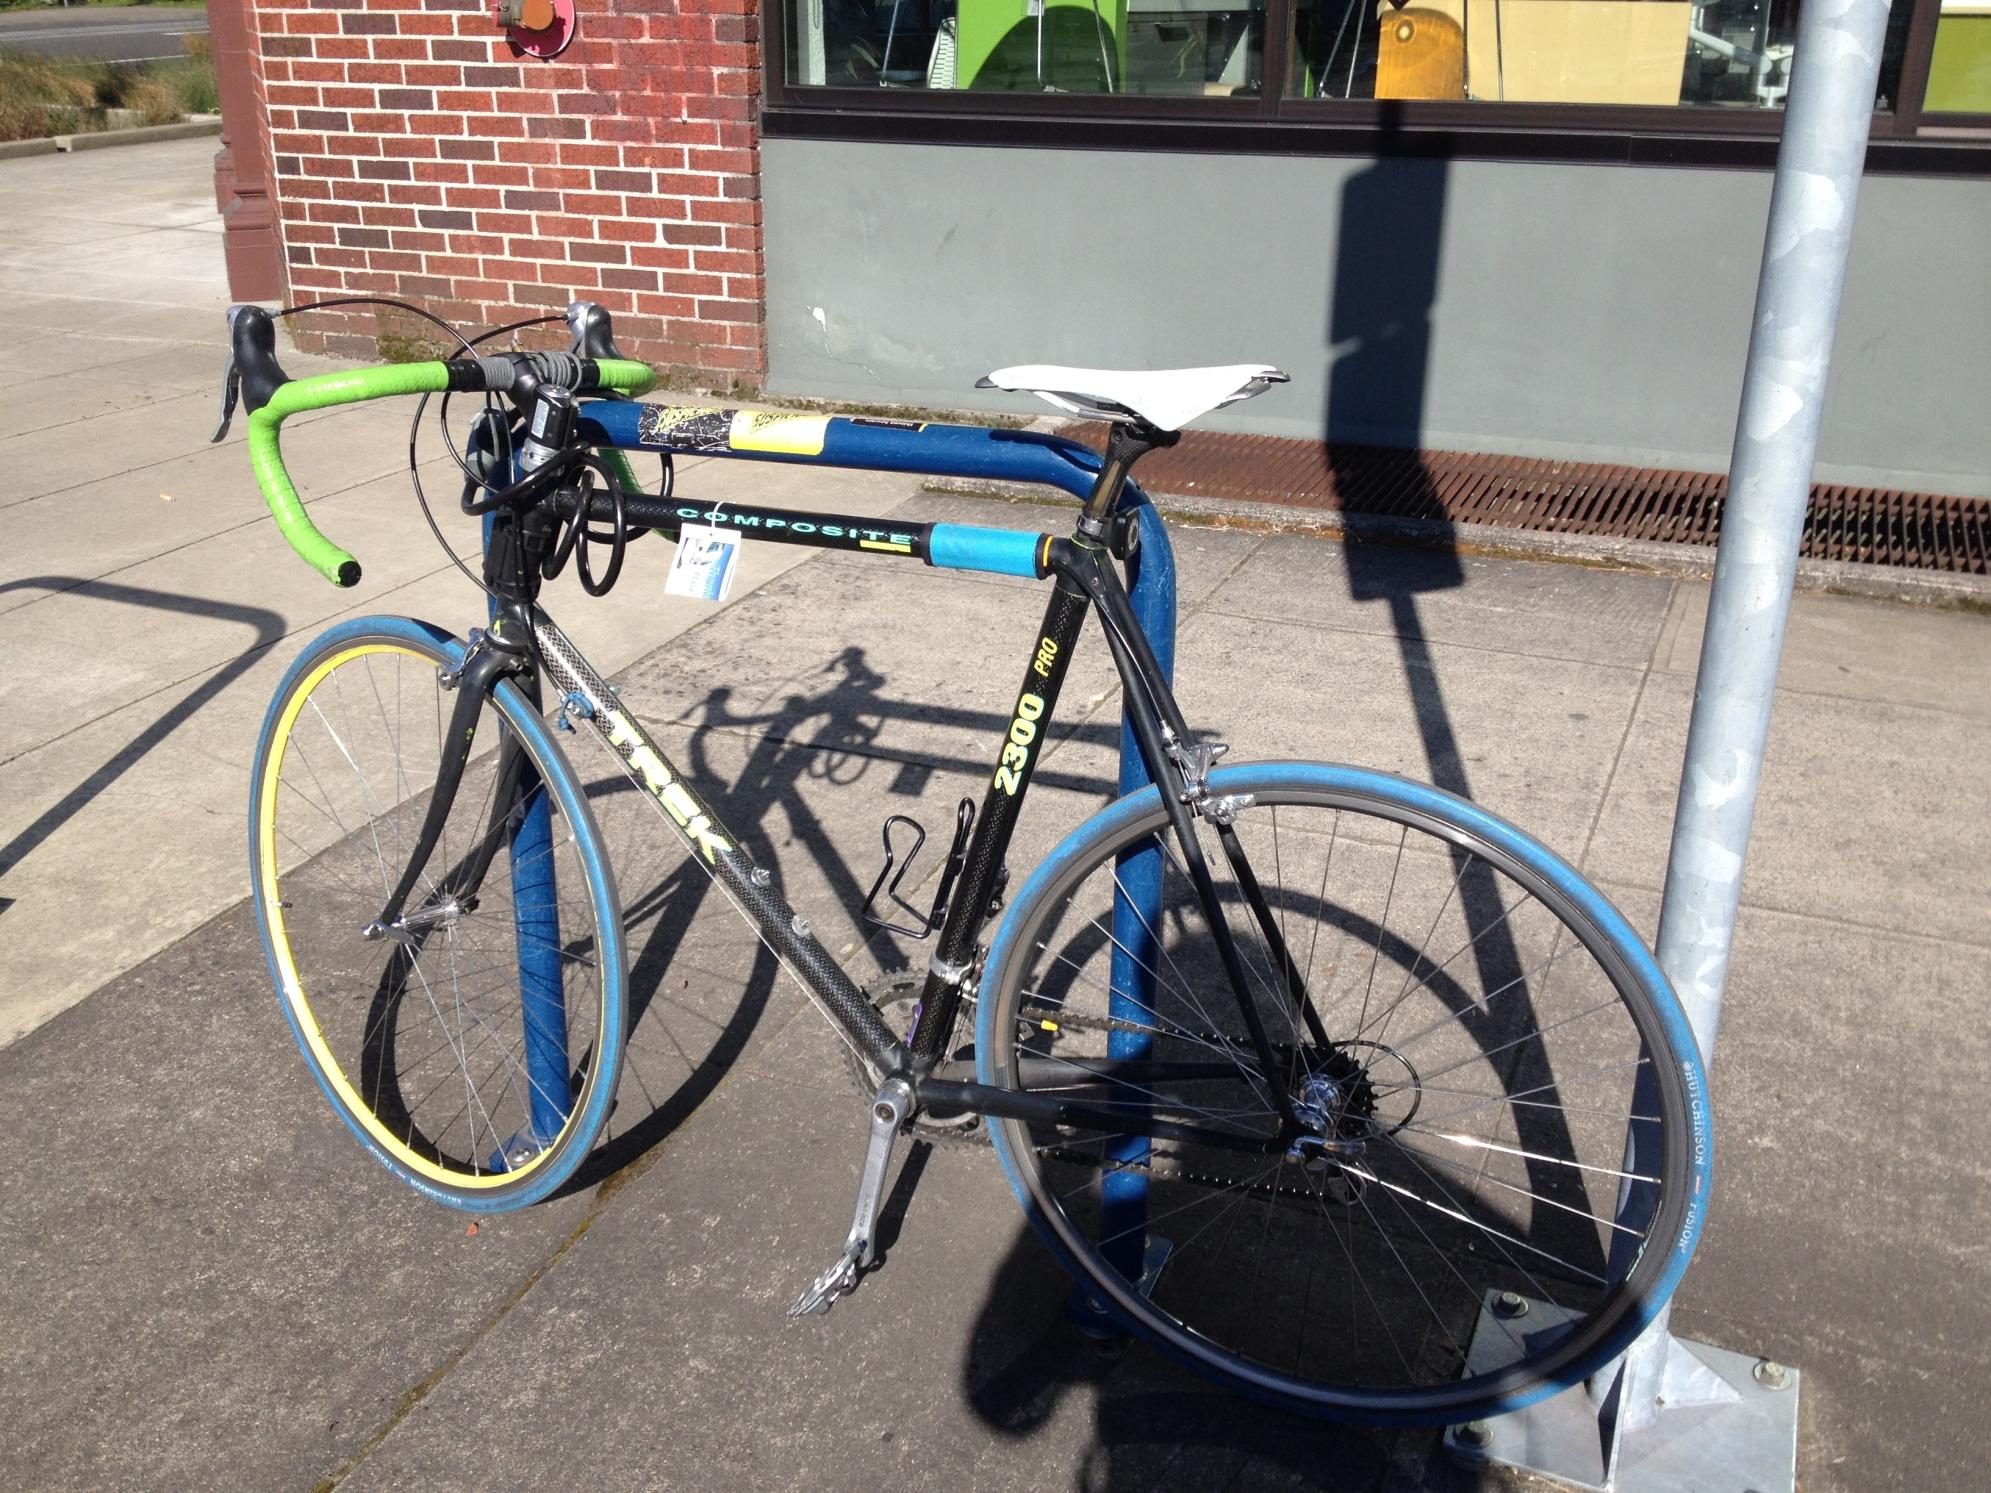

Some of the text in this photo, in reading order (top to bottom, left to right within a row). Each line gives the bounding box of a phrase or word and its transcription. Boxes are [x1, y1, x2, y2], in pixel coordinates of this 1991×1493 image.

[676, 508, 912, 545] COMPOSITE
[607, 709, 732, 865] TREK
[994, 637, 1058, 796] 2300 PRO
[1678, 1072, 1708, 1250] HUTCHINSON FUSION
